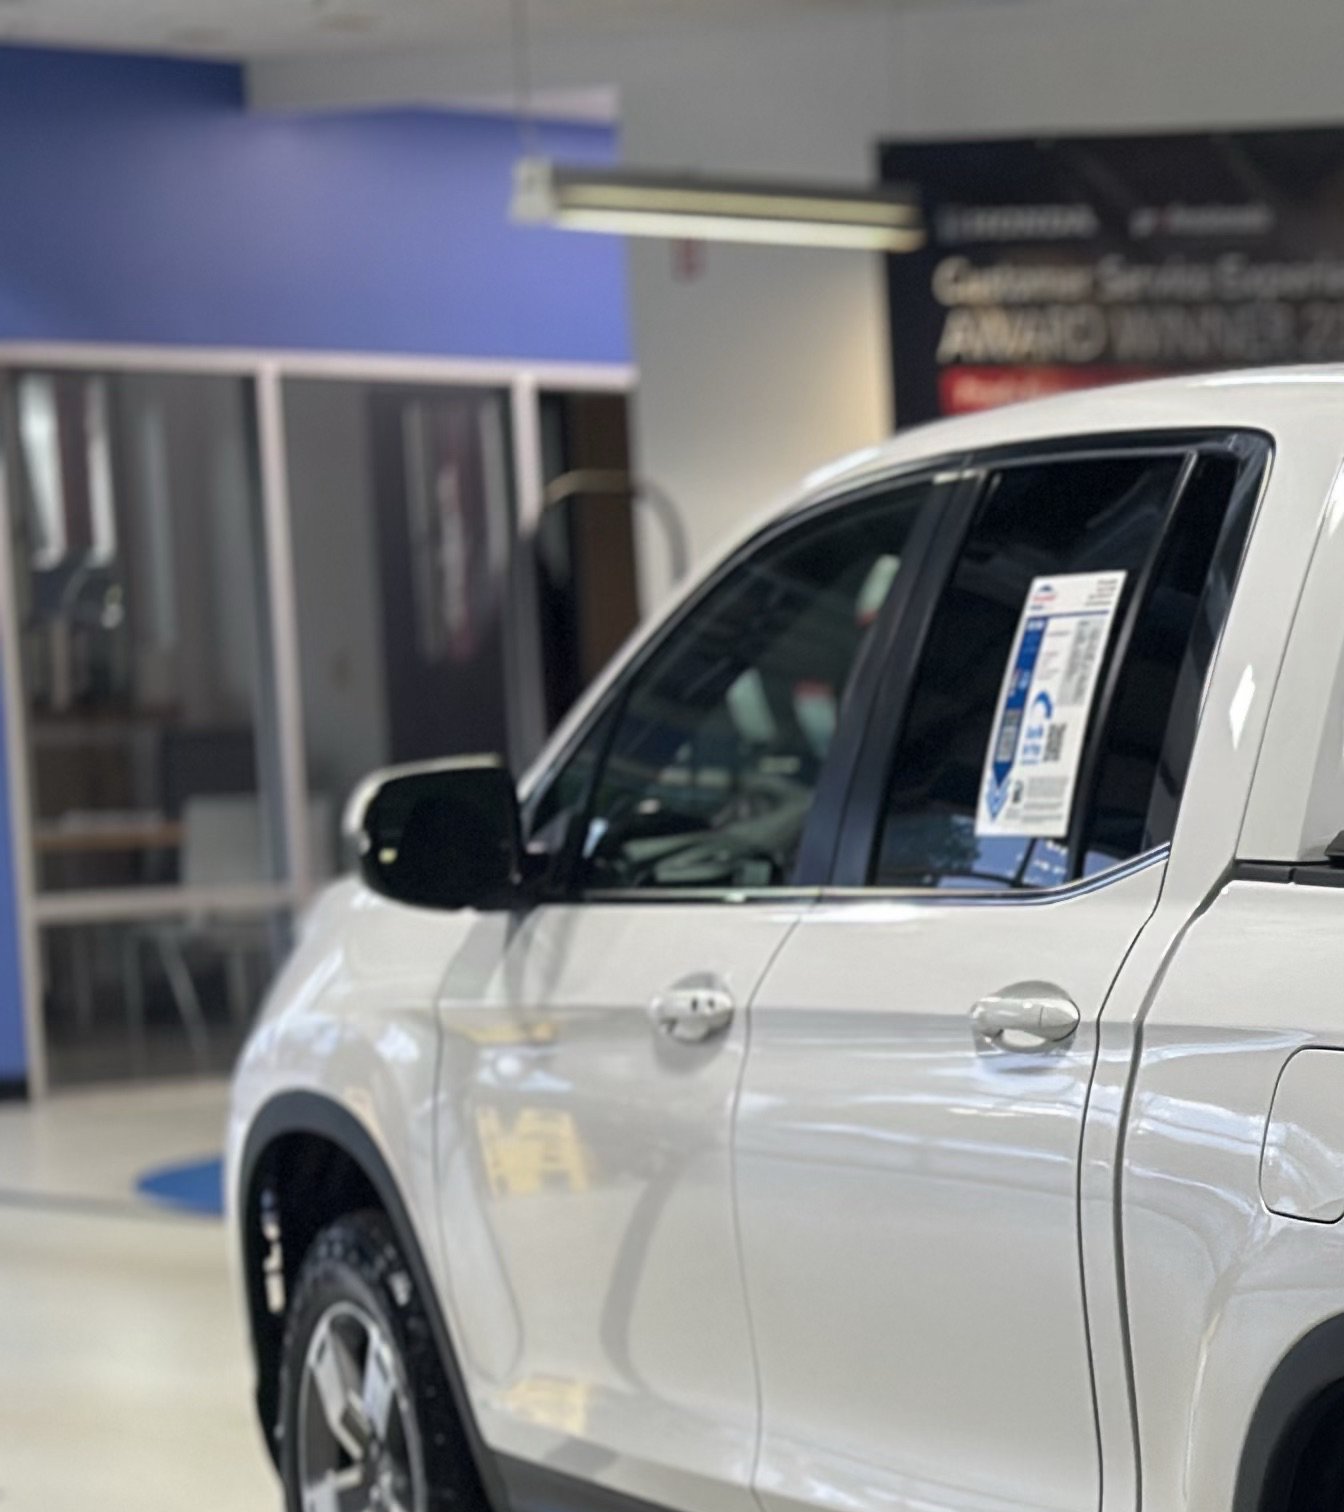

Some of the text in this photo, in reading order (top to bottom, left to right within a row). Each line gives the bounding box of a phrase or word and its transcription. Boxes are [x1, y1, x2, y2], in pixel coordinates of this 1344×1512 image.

[933, 255, 1092, 306] Customer
[1096, 254, 1211, 302] Service
[935, 305, 1107, 363] AWARD
